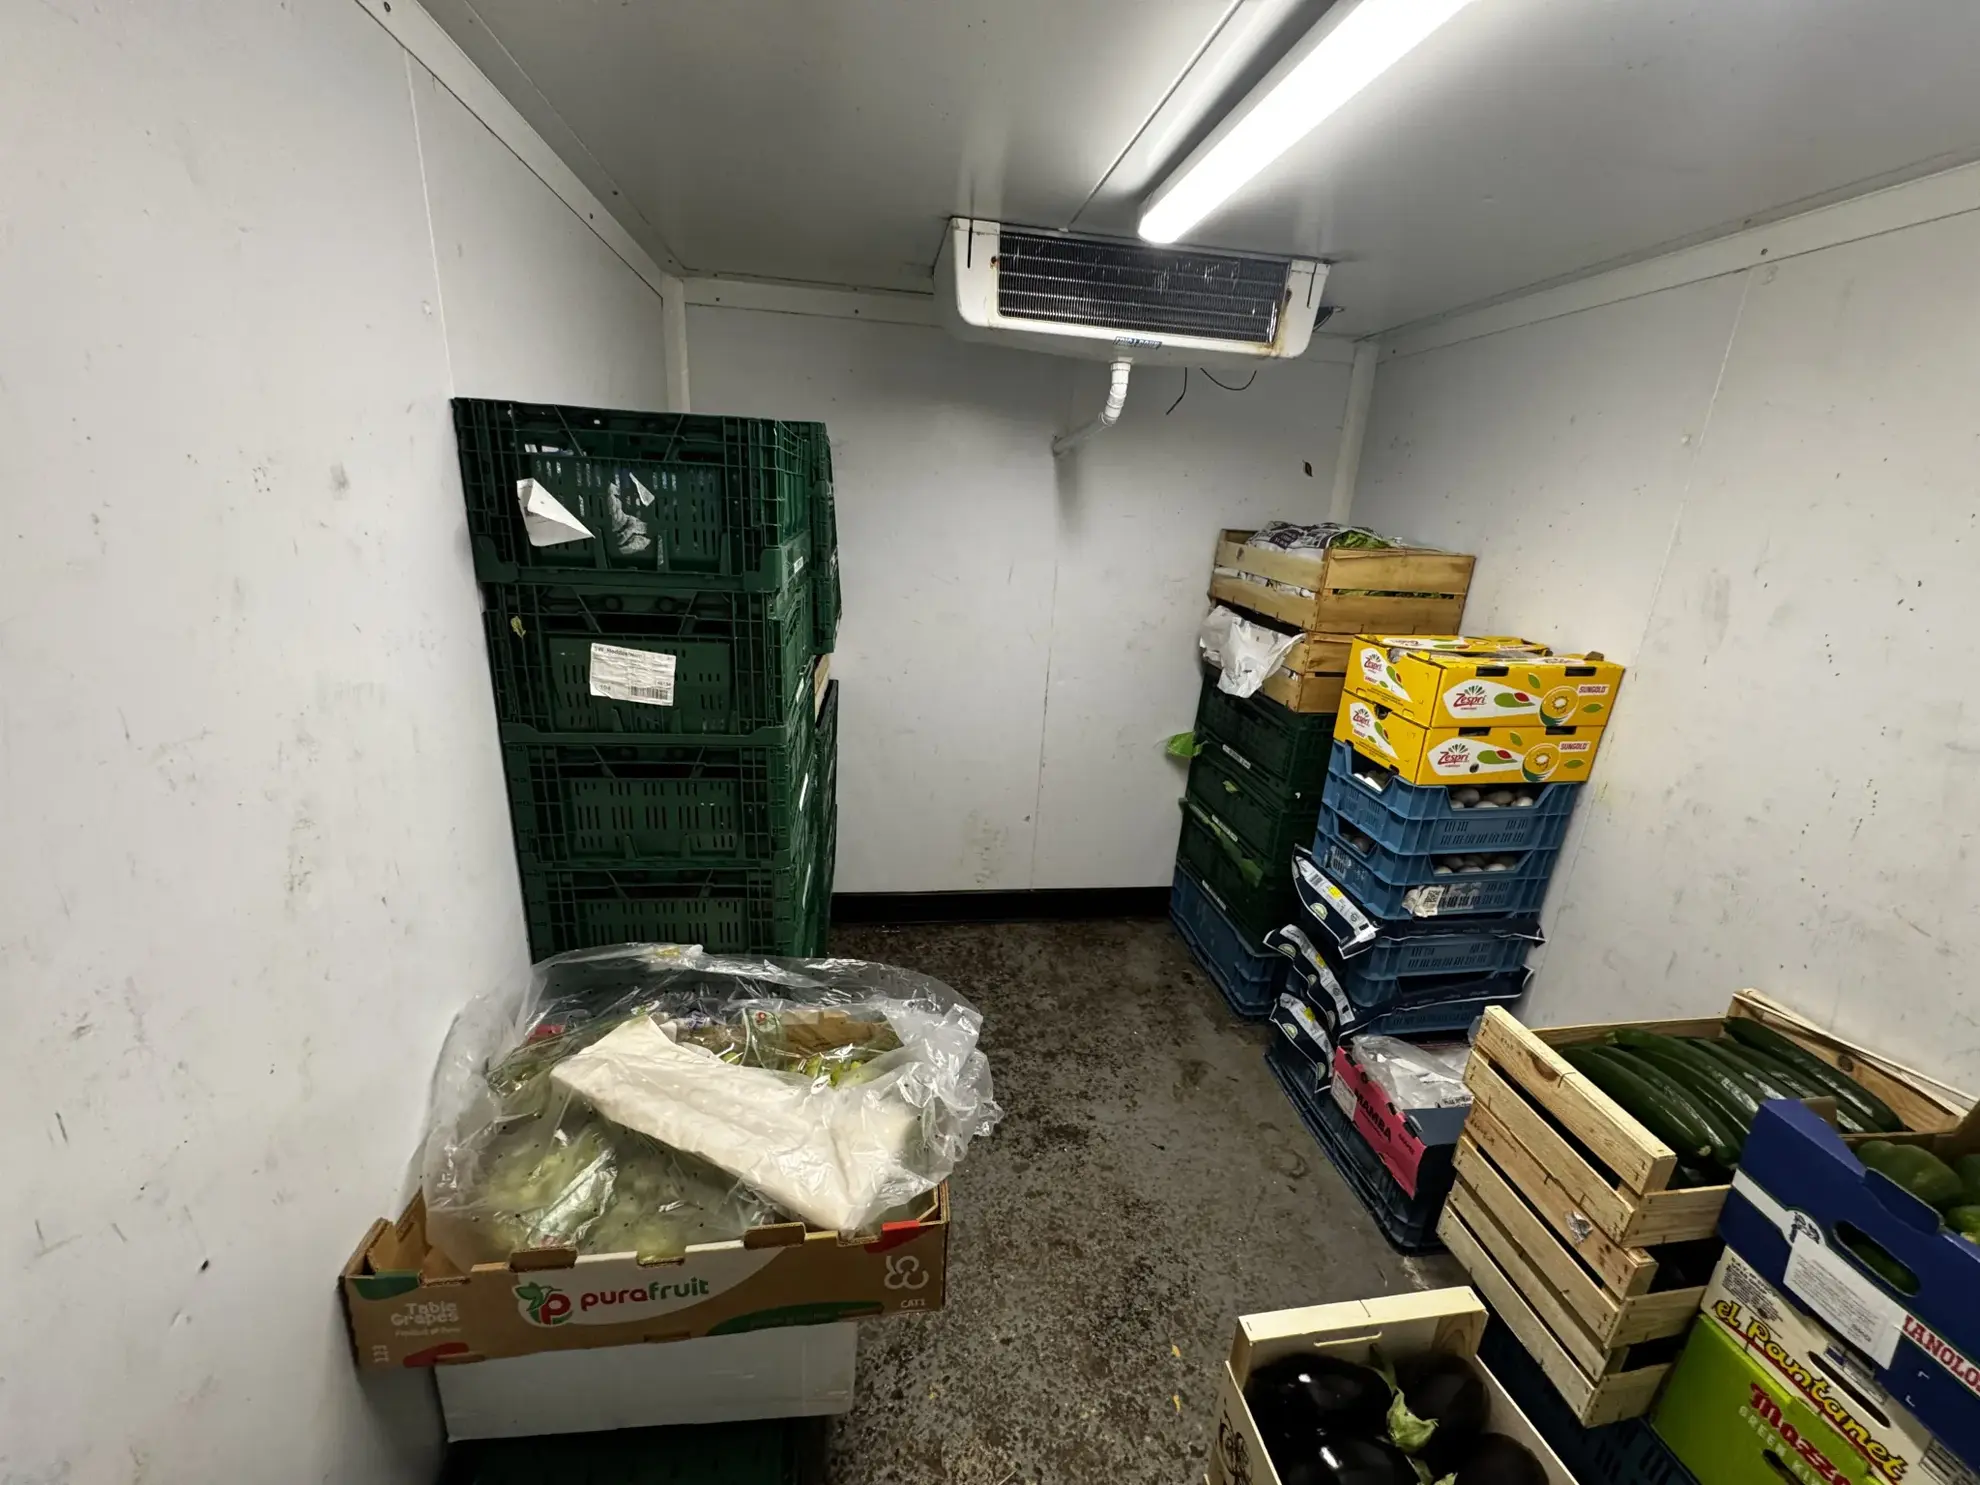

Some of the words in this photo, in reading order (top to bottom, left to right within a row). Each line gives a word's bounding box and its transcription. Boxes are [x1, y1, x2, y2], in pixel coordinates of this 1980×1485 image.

[1578, 686, 1607, 694] SUNGOLD
[1453, 693, 1487, 708] Zespri
[1437, 751, 1470, 765] Zespri
[580, 1279, 709, 1311] purafruit
[404, 1301, 457, 1315] Table
[391, 1313, 460, 1326] Grapes
